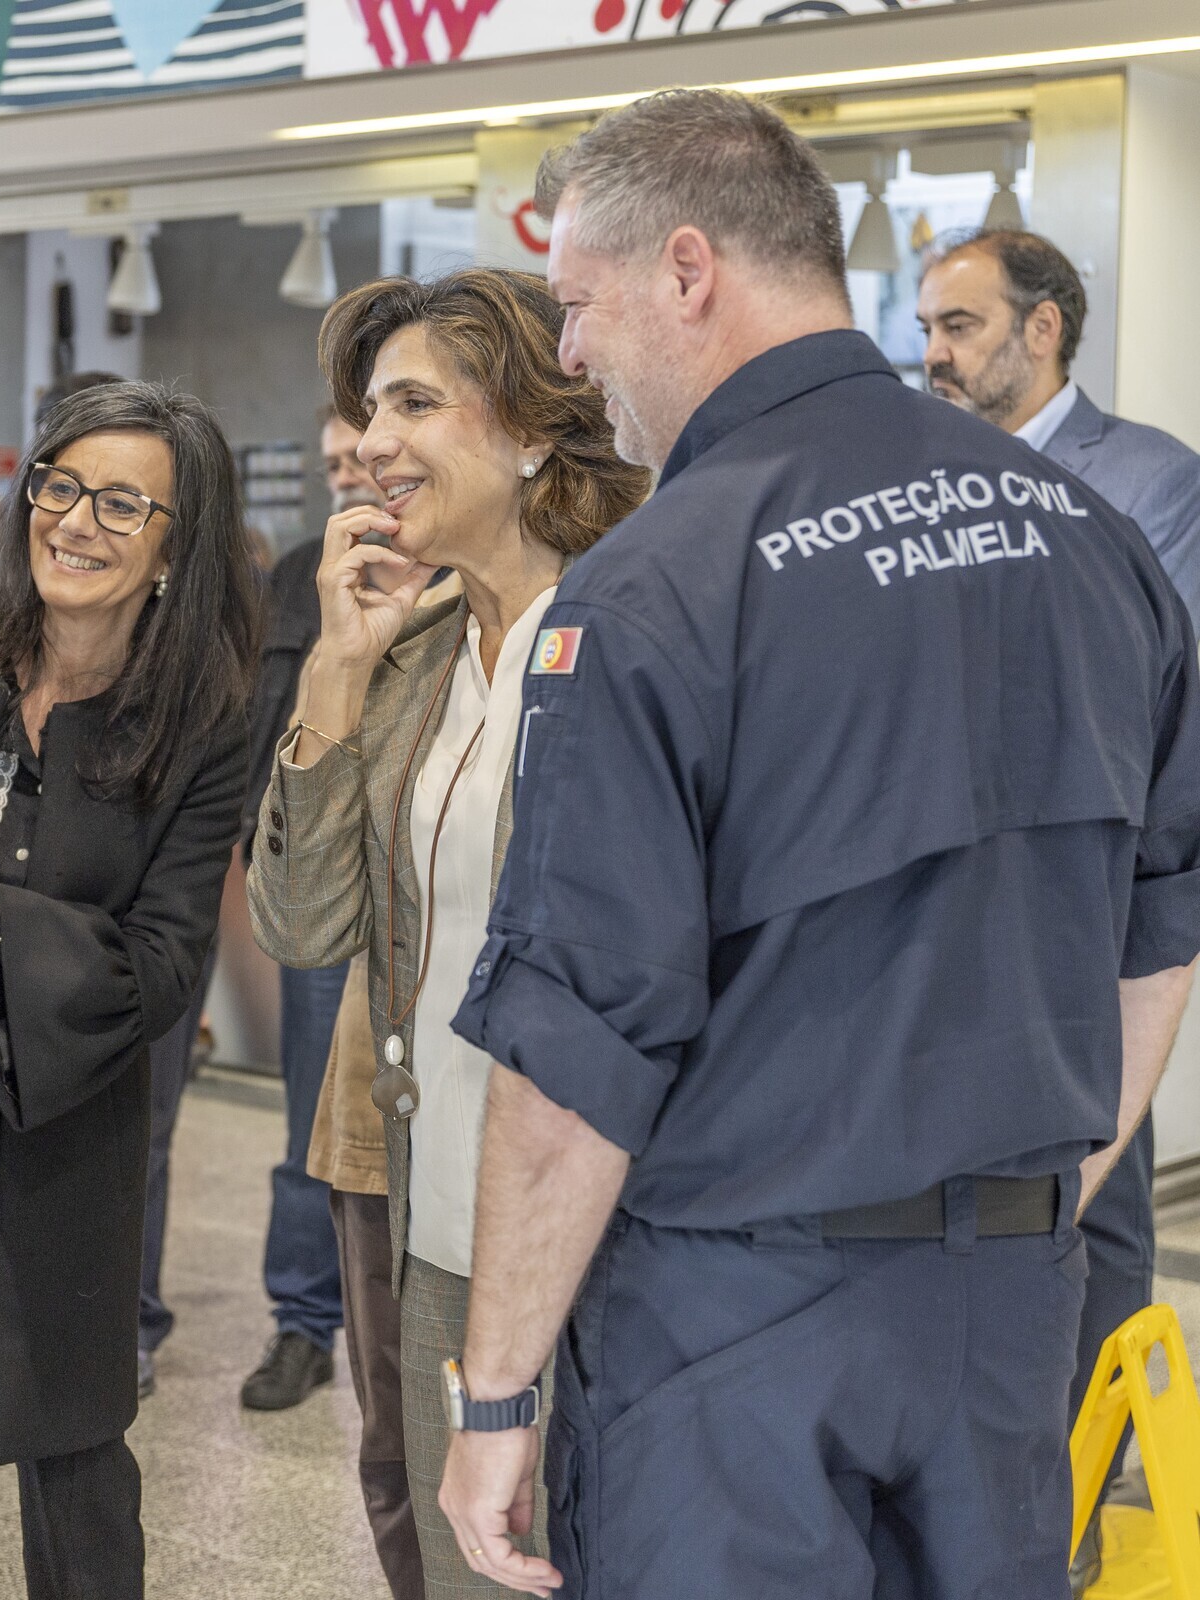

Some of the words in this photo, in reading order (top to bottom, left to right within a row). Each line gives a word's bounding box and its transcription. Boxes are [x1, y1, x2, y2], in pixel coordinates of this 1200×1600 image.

[755, 468, 996, 572] PROTEÇÃO
[1000, 470, 1088, 517] CIVIL
[864, 520, 1051, 587] PALMELA
